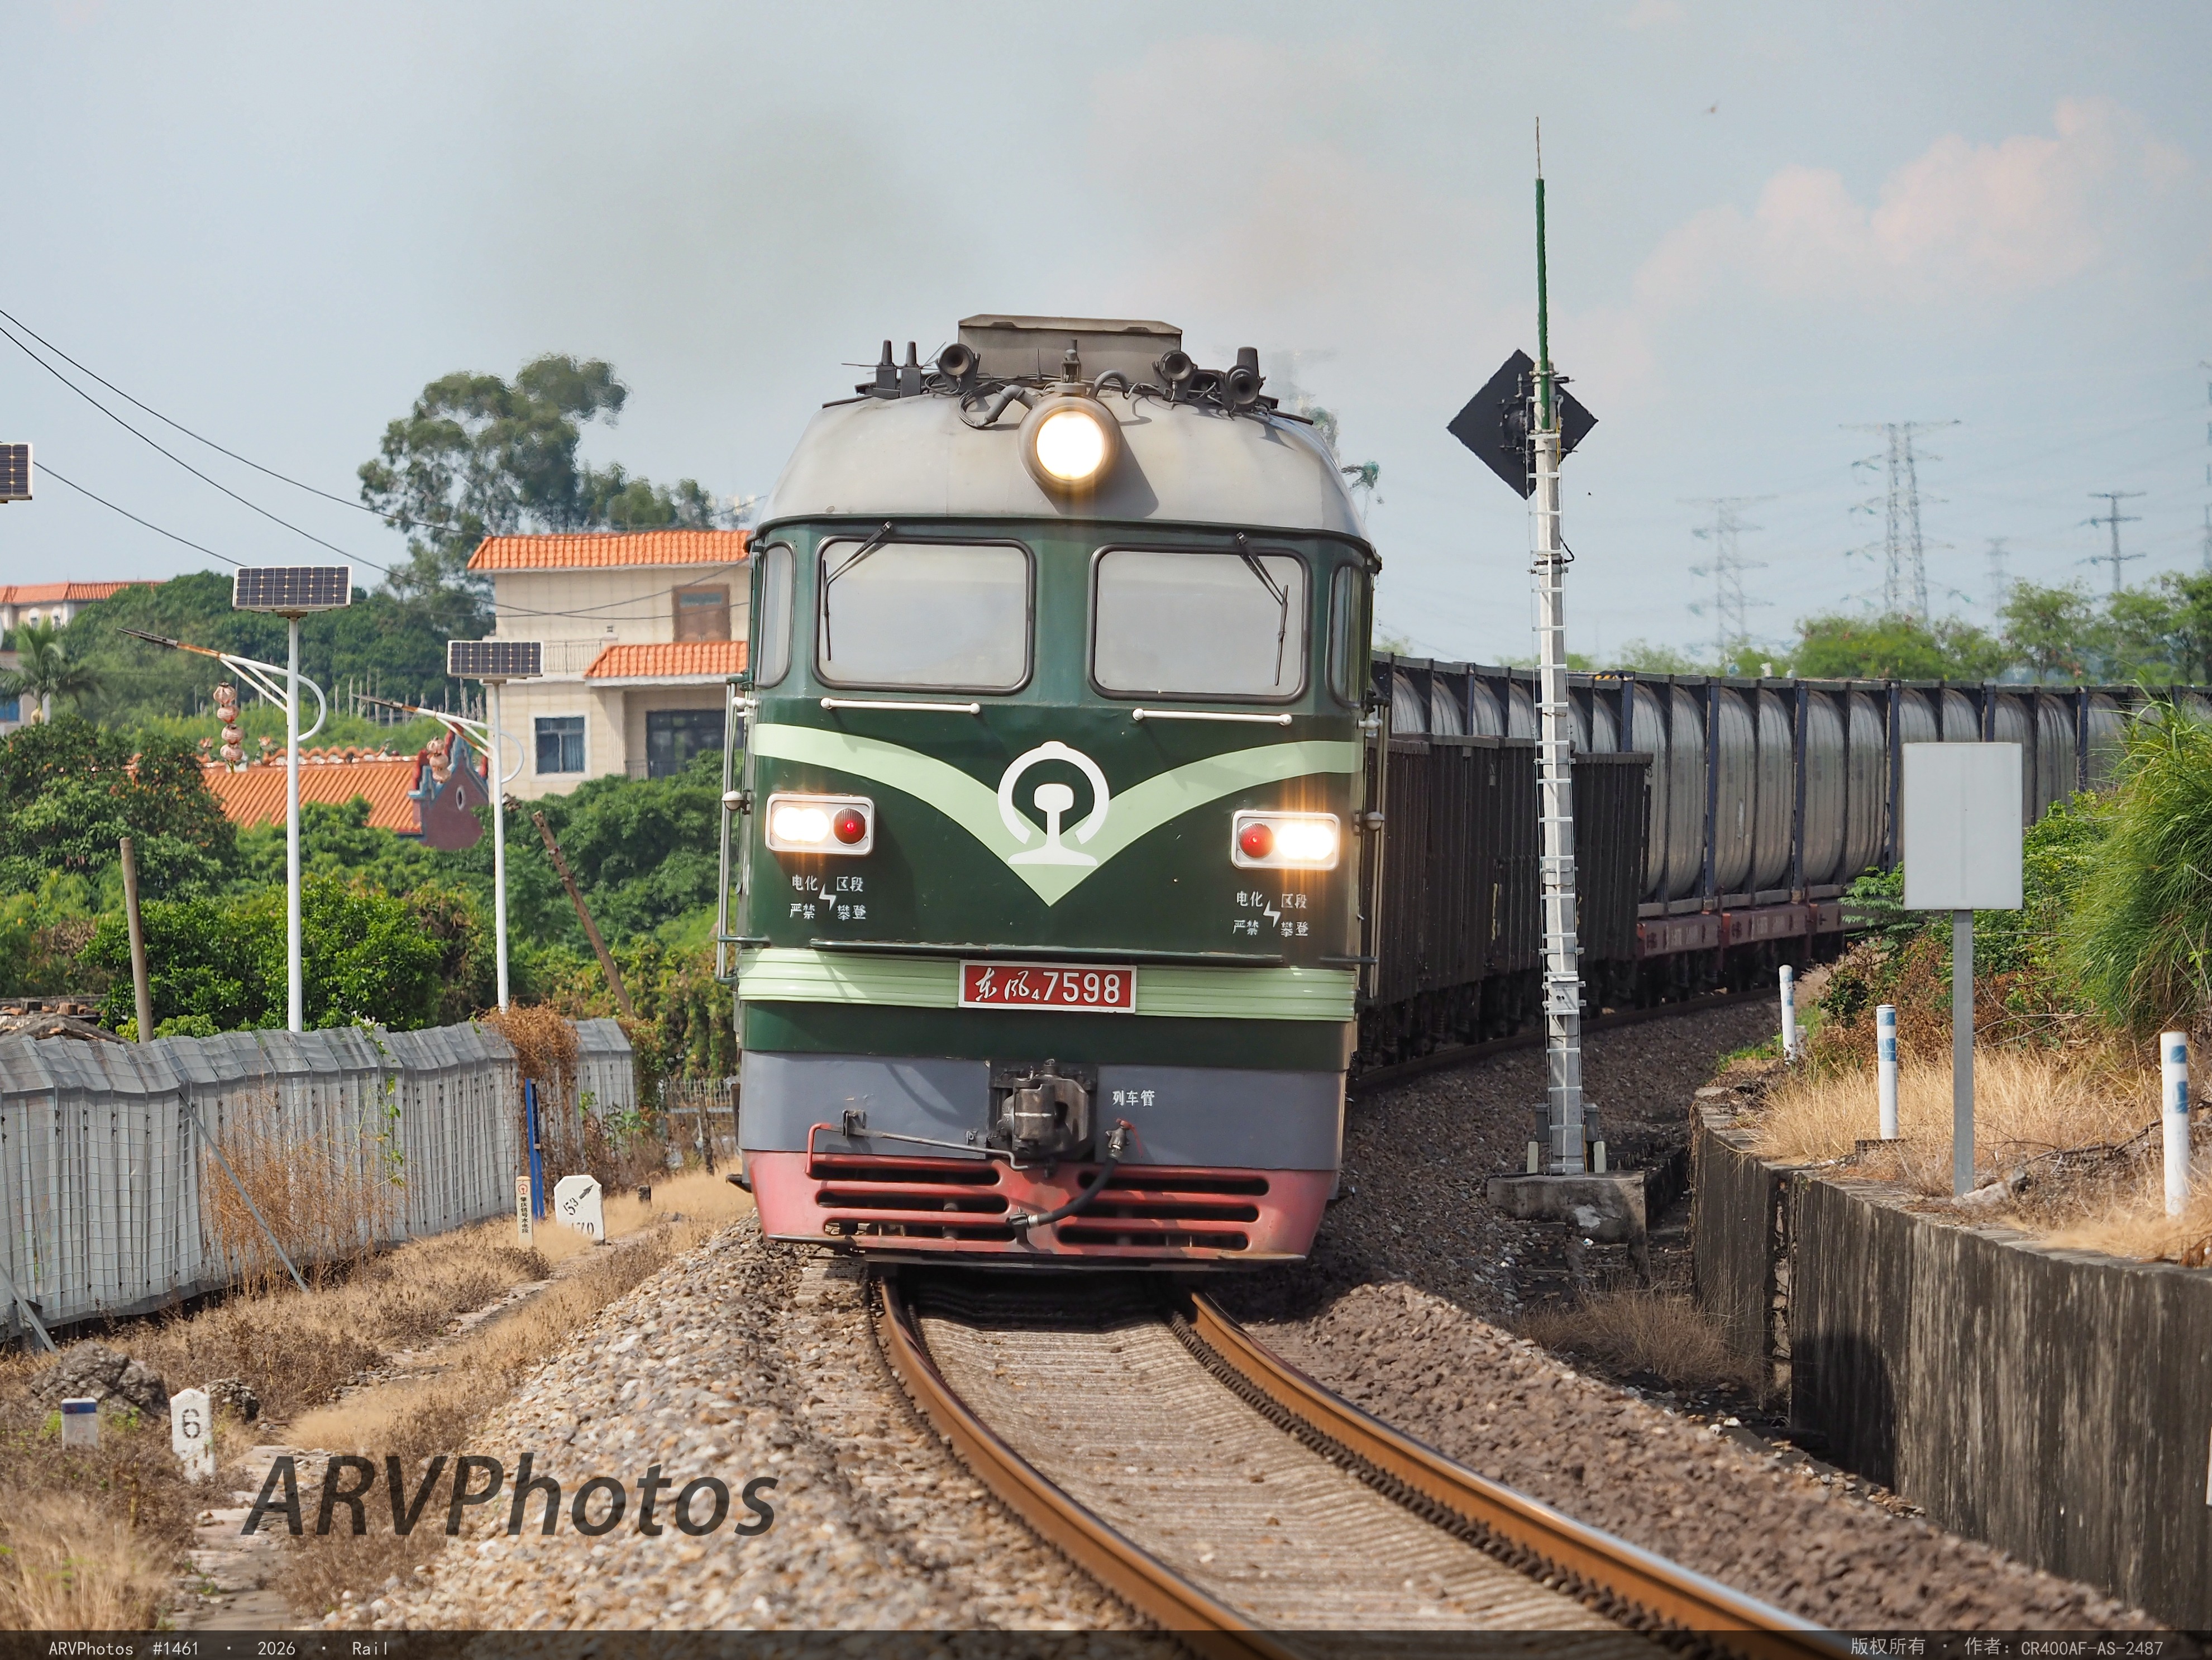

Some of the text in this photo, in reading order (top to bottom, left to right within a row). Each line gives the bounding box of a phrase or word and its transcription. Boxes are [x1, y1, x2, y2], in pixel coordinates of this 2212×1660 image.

[792, 875, 863, 892] 电化 区段
[1236, 890, 1307, 909] 电化 区段
[789, 903, 866, 921] 严禁 攀登
[1232, 919, 1308, 937] 严禁 攀登
[1112, 1090, 1155, 1107] 列车管
[563, 1197, 579, 1215] 53
[181, 1408, 200, 1439] 6
